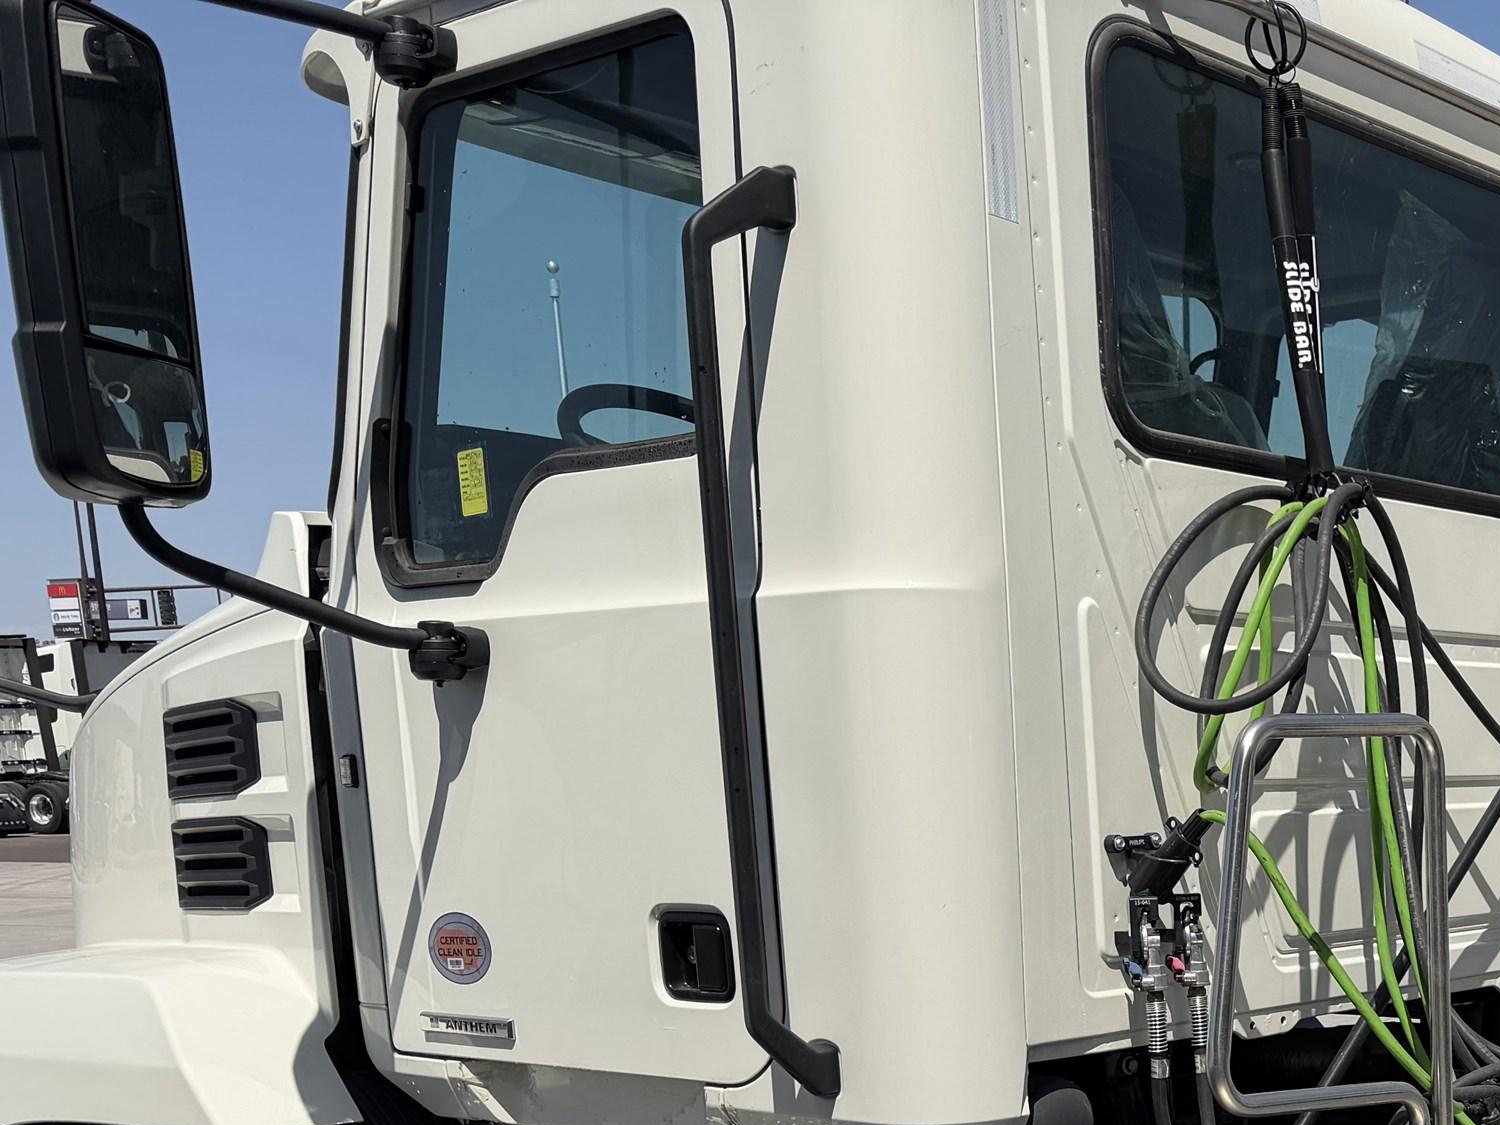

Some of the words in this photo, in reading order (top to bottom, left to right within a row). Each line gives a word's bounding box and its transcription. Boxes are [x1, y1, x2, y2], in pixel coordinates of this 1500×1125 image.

[1283, 261, 1304, 313] SLIDE
[439, 936, 478, 946] CERTIFIED
[437, 947, 463, 957] CLEAN
[465, 948, 483, 957] IDLE
[445, 1018, 497, 1034] ANTHEM
